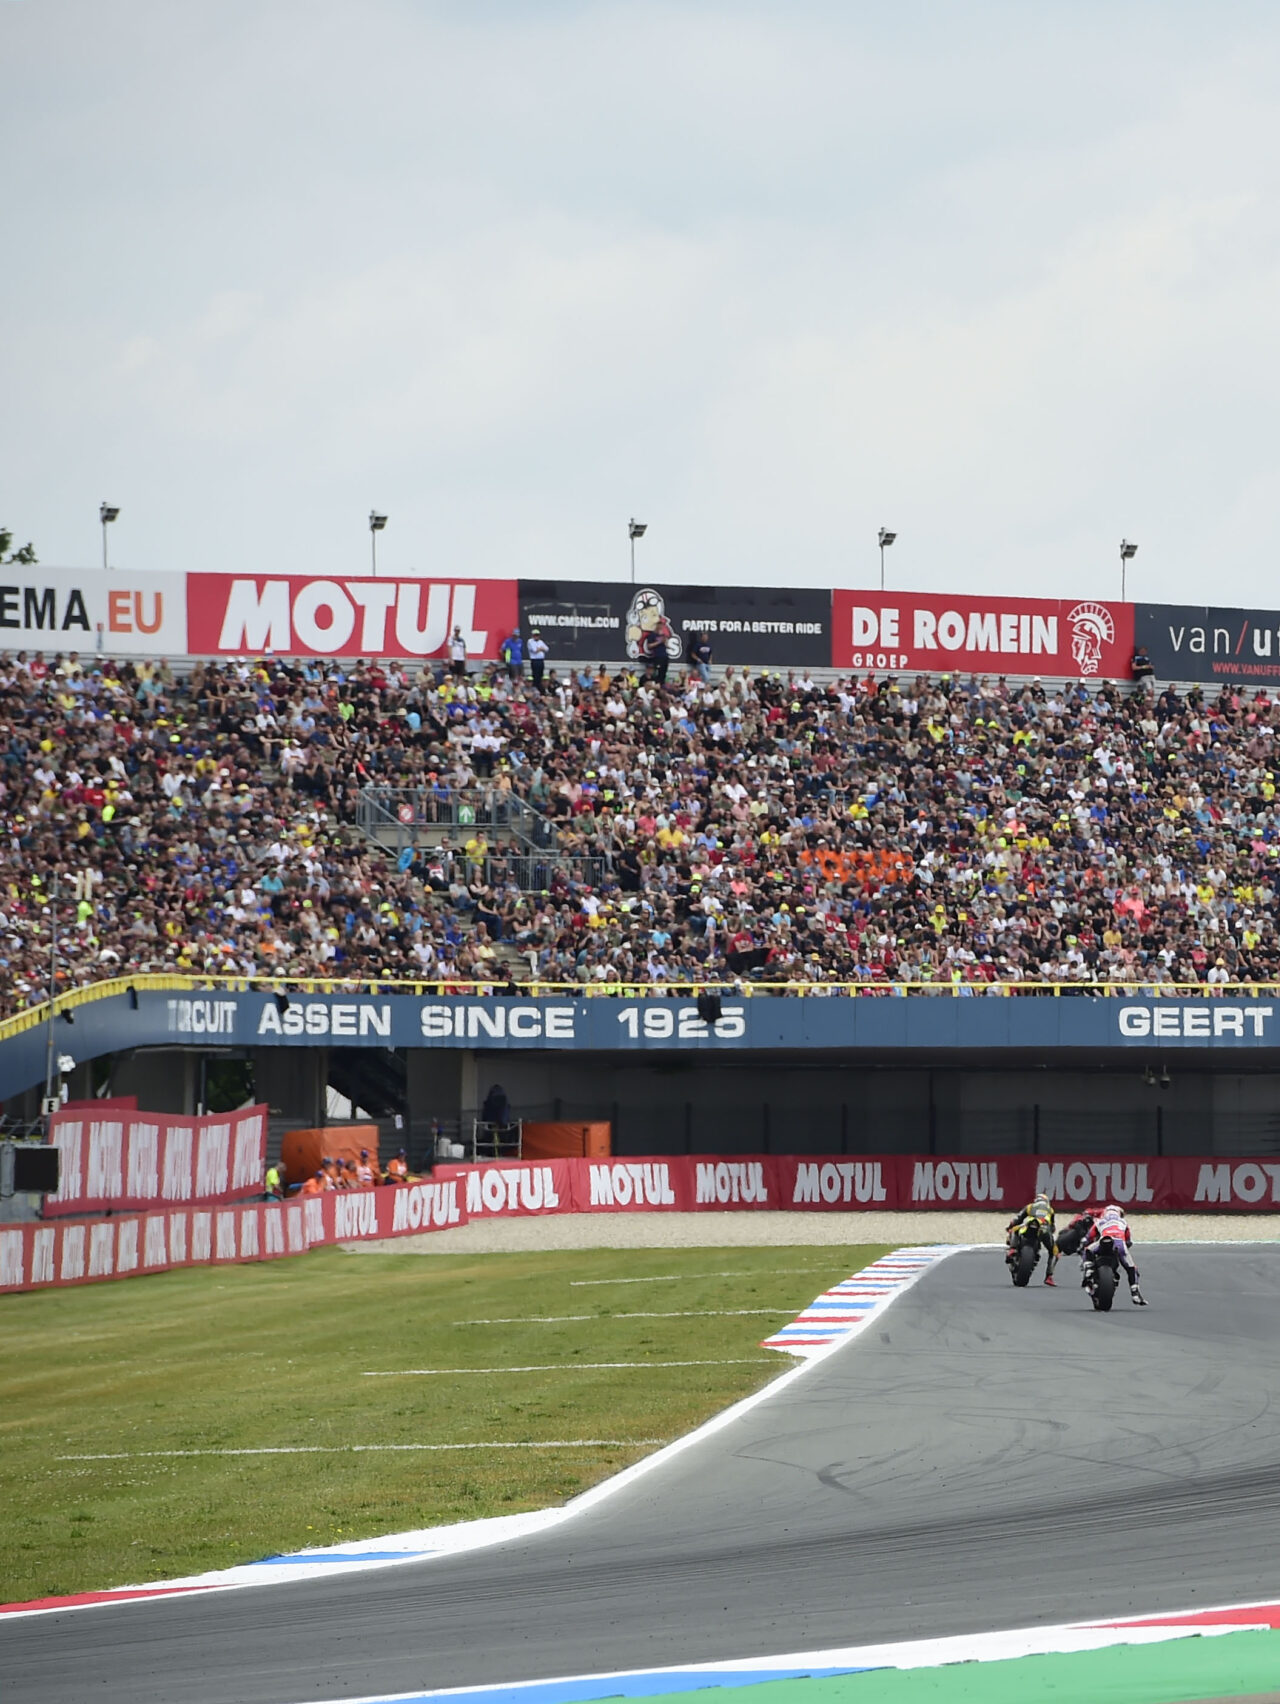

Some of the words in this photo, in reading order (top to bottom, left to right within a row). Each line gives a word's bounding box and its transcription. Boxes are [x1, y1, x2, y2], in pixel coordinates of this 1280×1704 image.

[218, 580, 488, 655] MOTUL
[528, 615, 620, 630] WWW.CMSNL.COM
[682, 620, 718, 632] PARTS
[720, 620, 742, 632] FOR
[743, 621, 751, 632] A
[752, 621, 794, 634] BETTER
[795, 622, 822, 634] RIDE
[852, 606, 900, 648] DE
[913, 609, 1058, 655] ROMEIN
[852, 653, 908, 669] GROEP
[257, 1002, 391, 1036] ASSEN
[420, 1005, 575, 1038] SINCE
[617, 1006, 746, 1039] 1925
[1118, 1006, 1273, 1037] GEERT
[466, 1167, 560, 1213] MOTUL
[589, 1163, 676, 1206] MOTUL
[695, 1161, 768, 1204] MOTUL
[792, 1162, 887, 1204] MOTUL
[911, 1161, 1005, 1202] MOTUL
[1034, 1162, 1155, 1202] MOTUL
[334, 1190, 379, 1239] MOTUL
[392, 1181, 461, 1232] MOTUL
